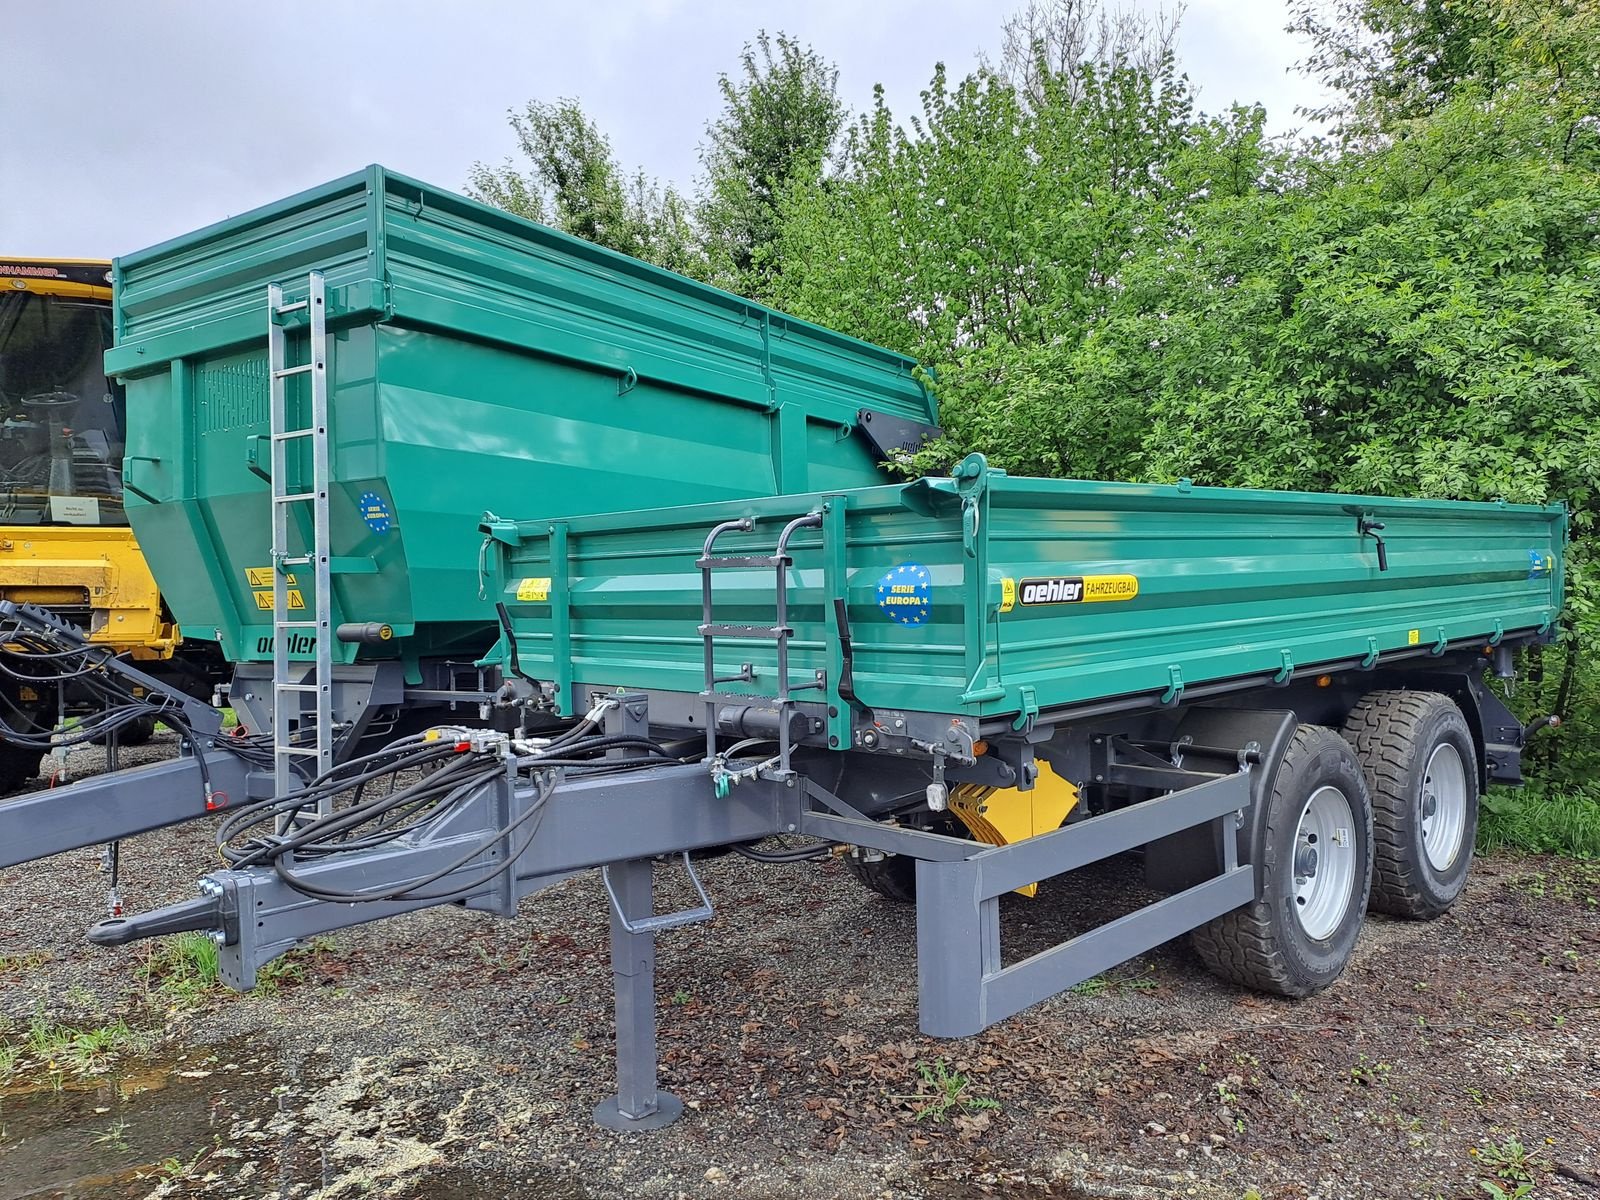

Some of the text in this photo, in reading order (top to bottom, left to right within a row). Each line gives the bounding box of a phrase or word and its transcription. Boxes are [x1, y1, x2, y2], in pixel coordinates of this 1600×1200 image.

[891, 585, 915, 593] SERIE
[1023, 580, 1137, 603] oehler FAHRZEUGBAU
[886, 596, 921, 605] EUROPA
[257, 633, 317, 654] oler
